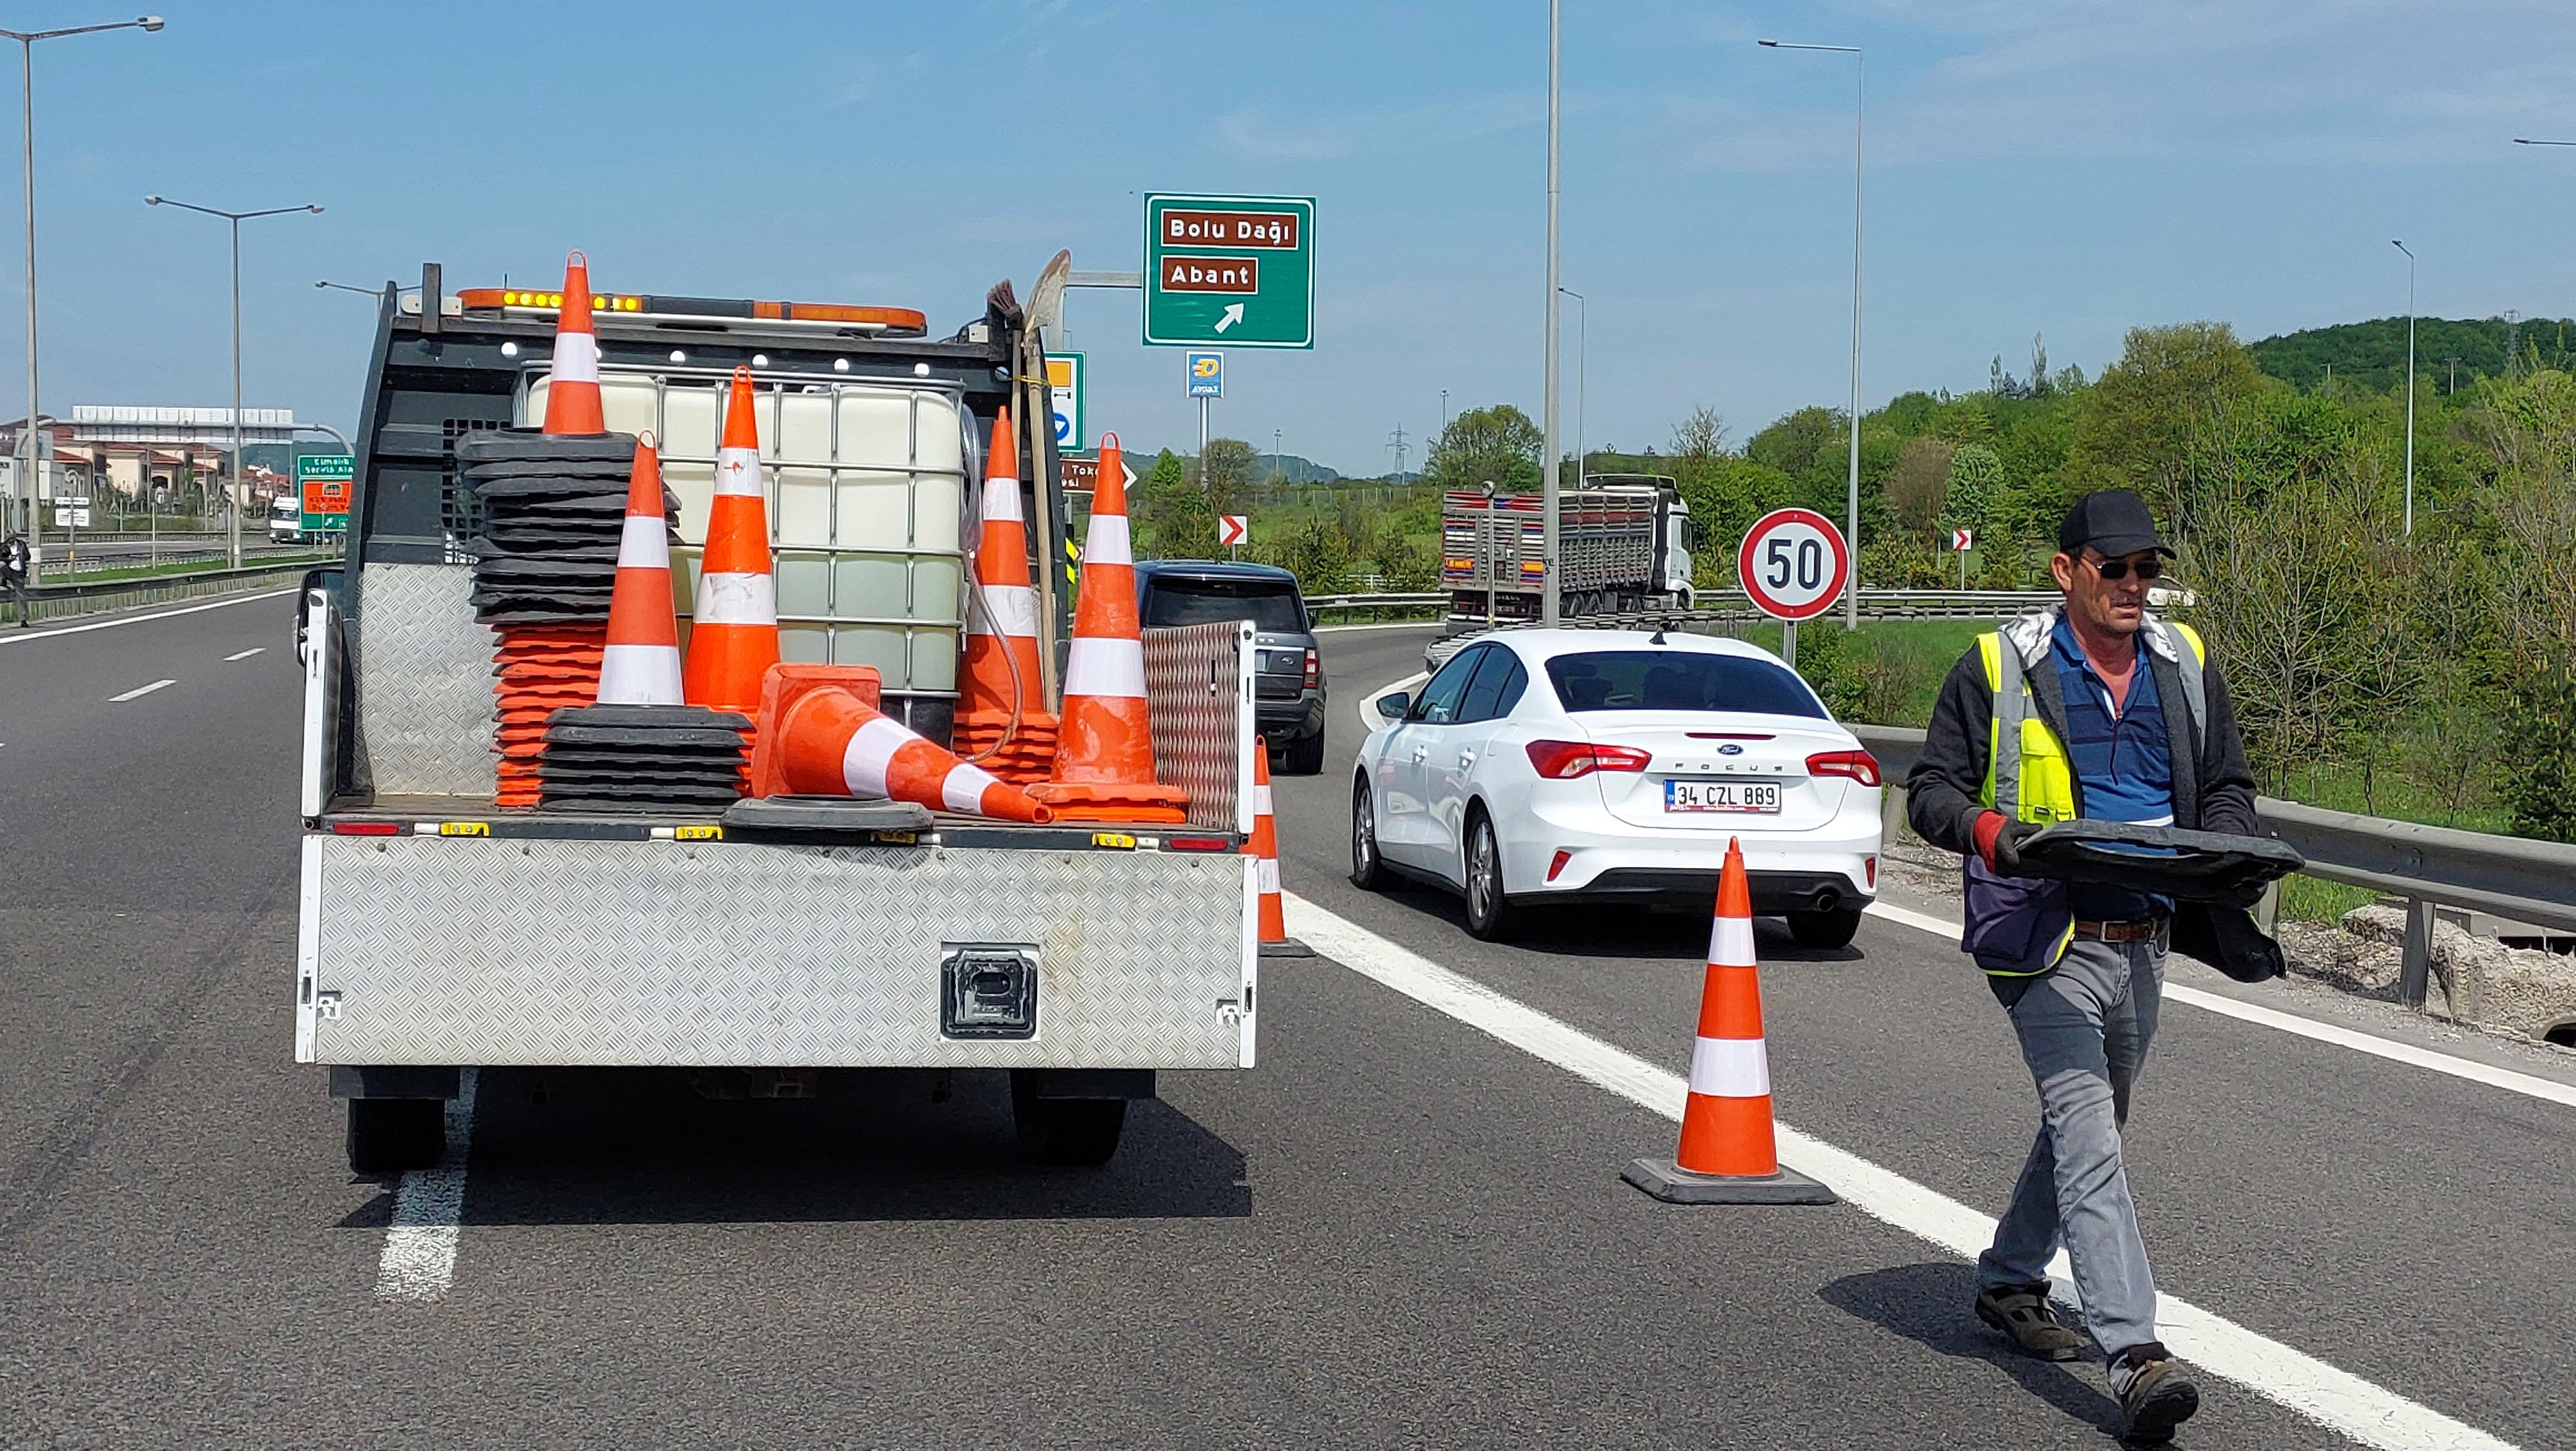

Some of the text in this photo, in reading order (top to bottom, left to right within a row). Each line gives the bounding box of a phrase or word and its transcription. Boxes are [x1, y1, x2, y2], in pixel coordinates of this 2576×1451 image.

[1171, 220, 1289, 245] Bolu Dağı
[1171, 265, 1248, 284] Abant
[1767, 539, 1822, 590] 50
[1678, 786, 1698, 805] 34
[1706, 787, 1737, 806] CZL
[1744, 787, 1775, 806] 889
